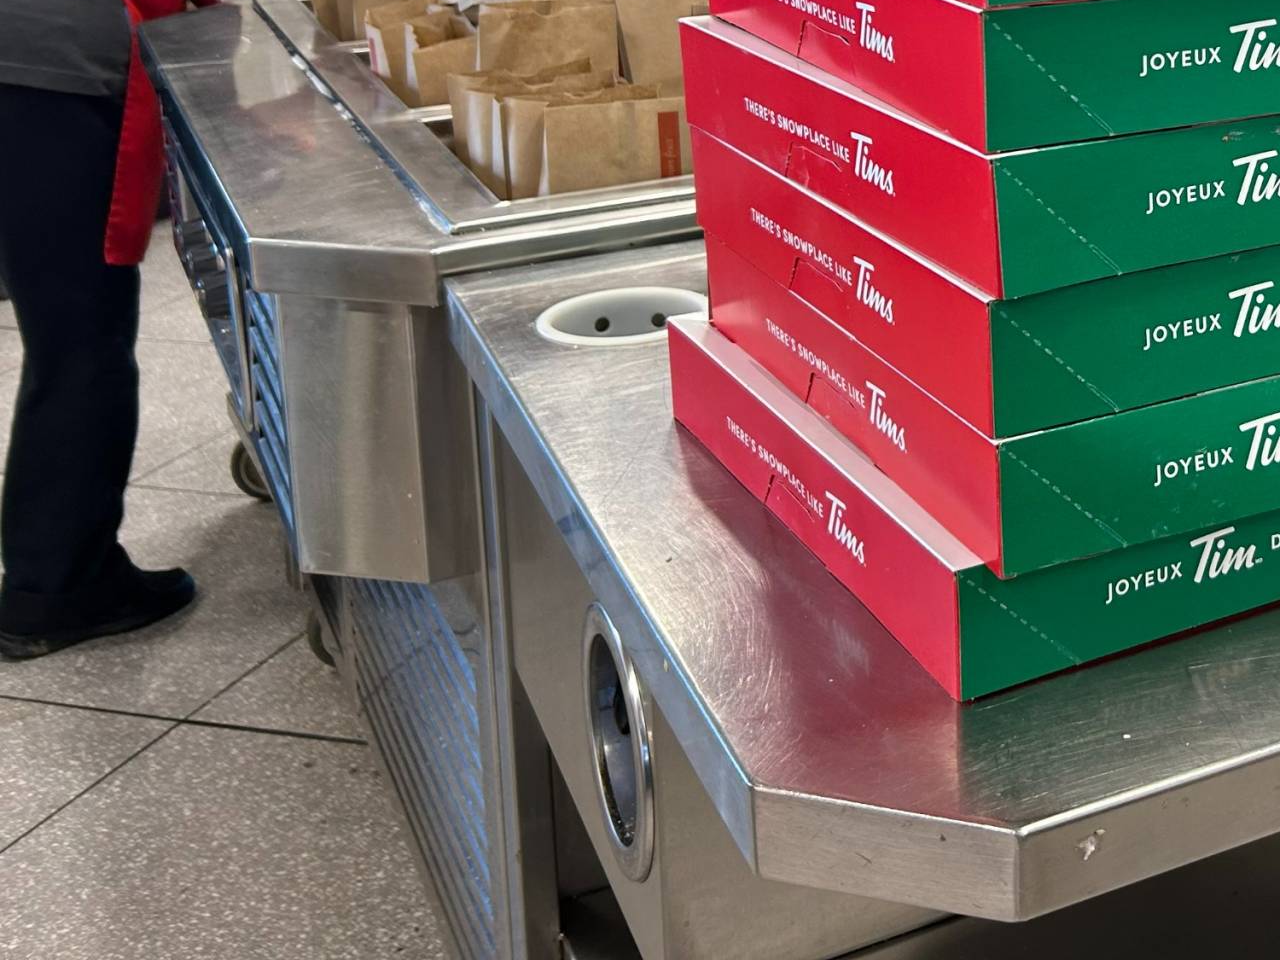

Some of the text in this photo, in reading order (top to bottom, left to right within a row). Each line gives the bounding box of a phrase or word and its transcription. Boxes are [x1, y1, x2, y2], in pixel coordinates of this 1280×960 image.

[838, 13, 857, 35] LIKE
[855, 1, 896, 63] Tims
[1139, 46, 1222, 77] JOYEUX
[744, 97, 896, 197] THERE'S SNOWPLACE LIKE Tims
[1146, 180, 1226, 215] JOYEUX
[750, 207, 896, 326] THERE'S SNOWPLACE LIKE Tims
[1143, 313, 1222, 351] JOYEUX
[765, 317, 908, 454] THERE'S SNOWPLACE LIKE Tims
[726, 415, 867, 567] THERE'S SNOWPLACE LIKE Tims
[1153, 446, 1234, 487] JOYEUX
[1105, 561, 1183, 605] JOYEUX
[1189, 526, 1257, 584] Tim
